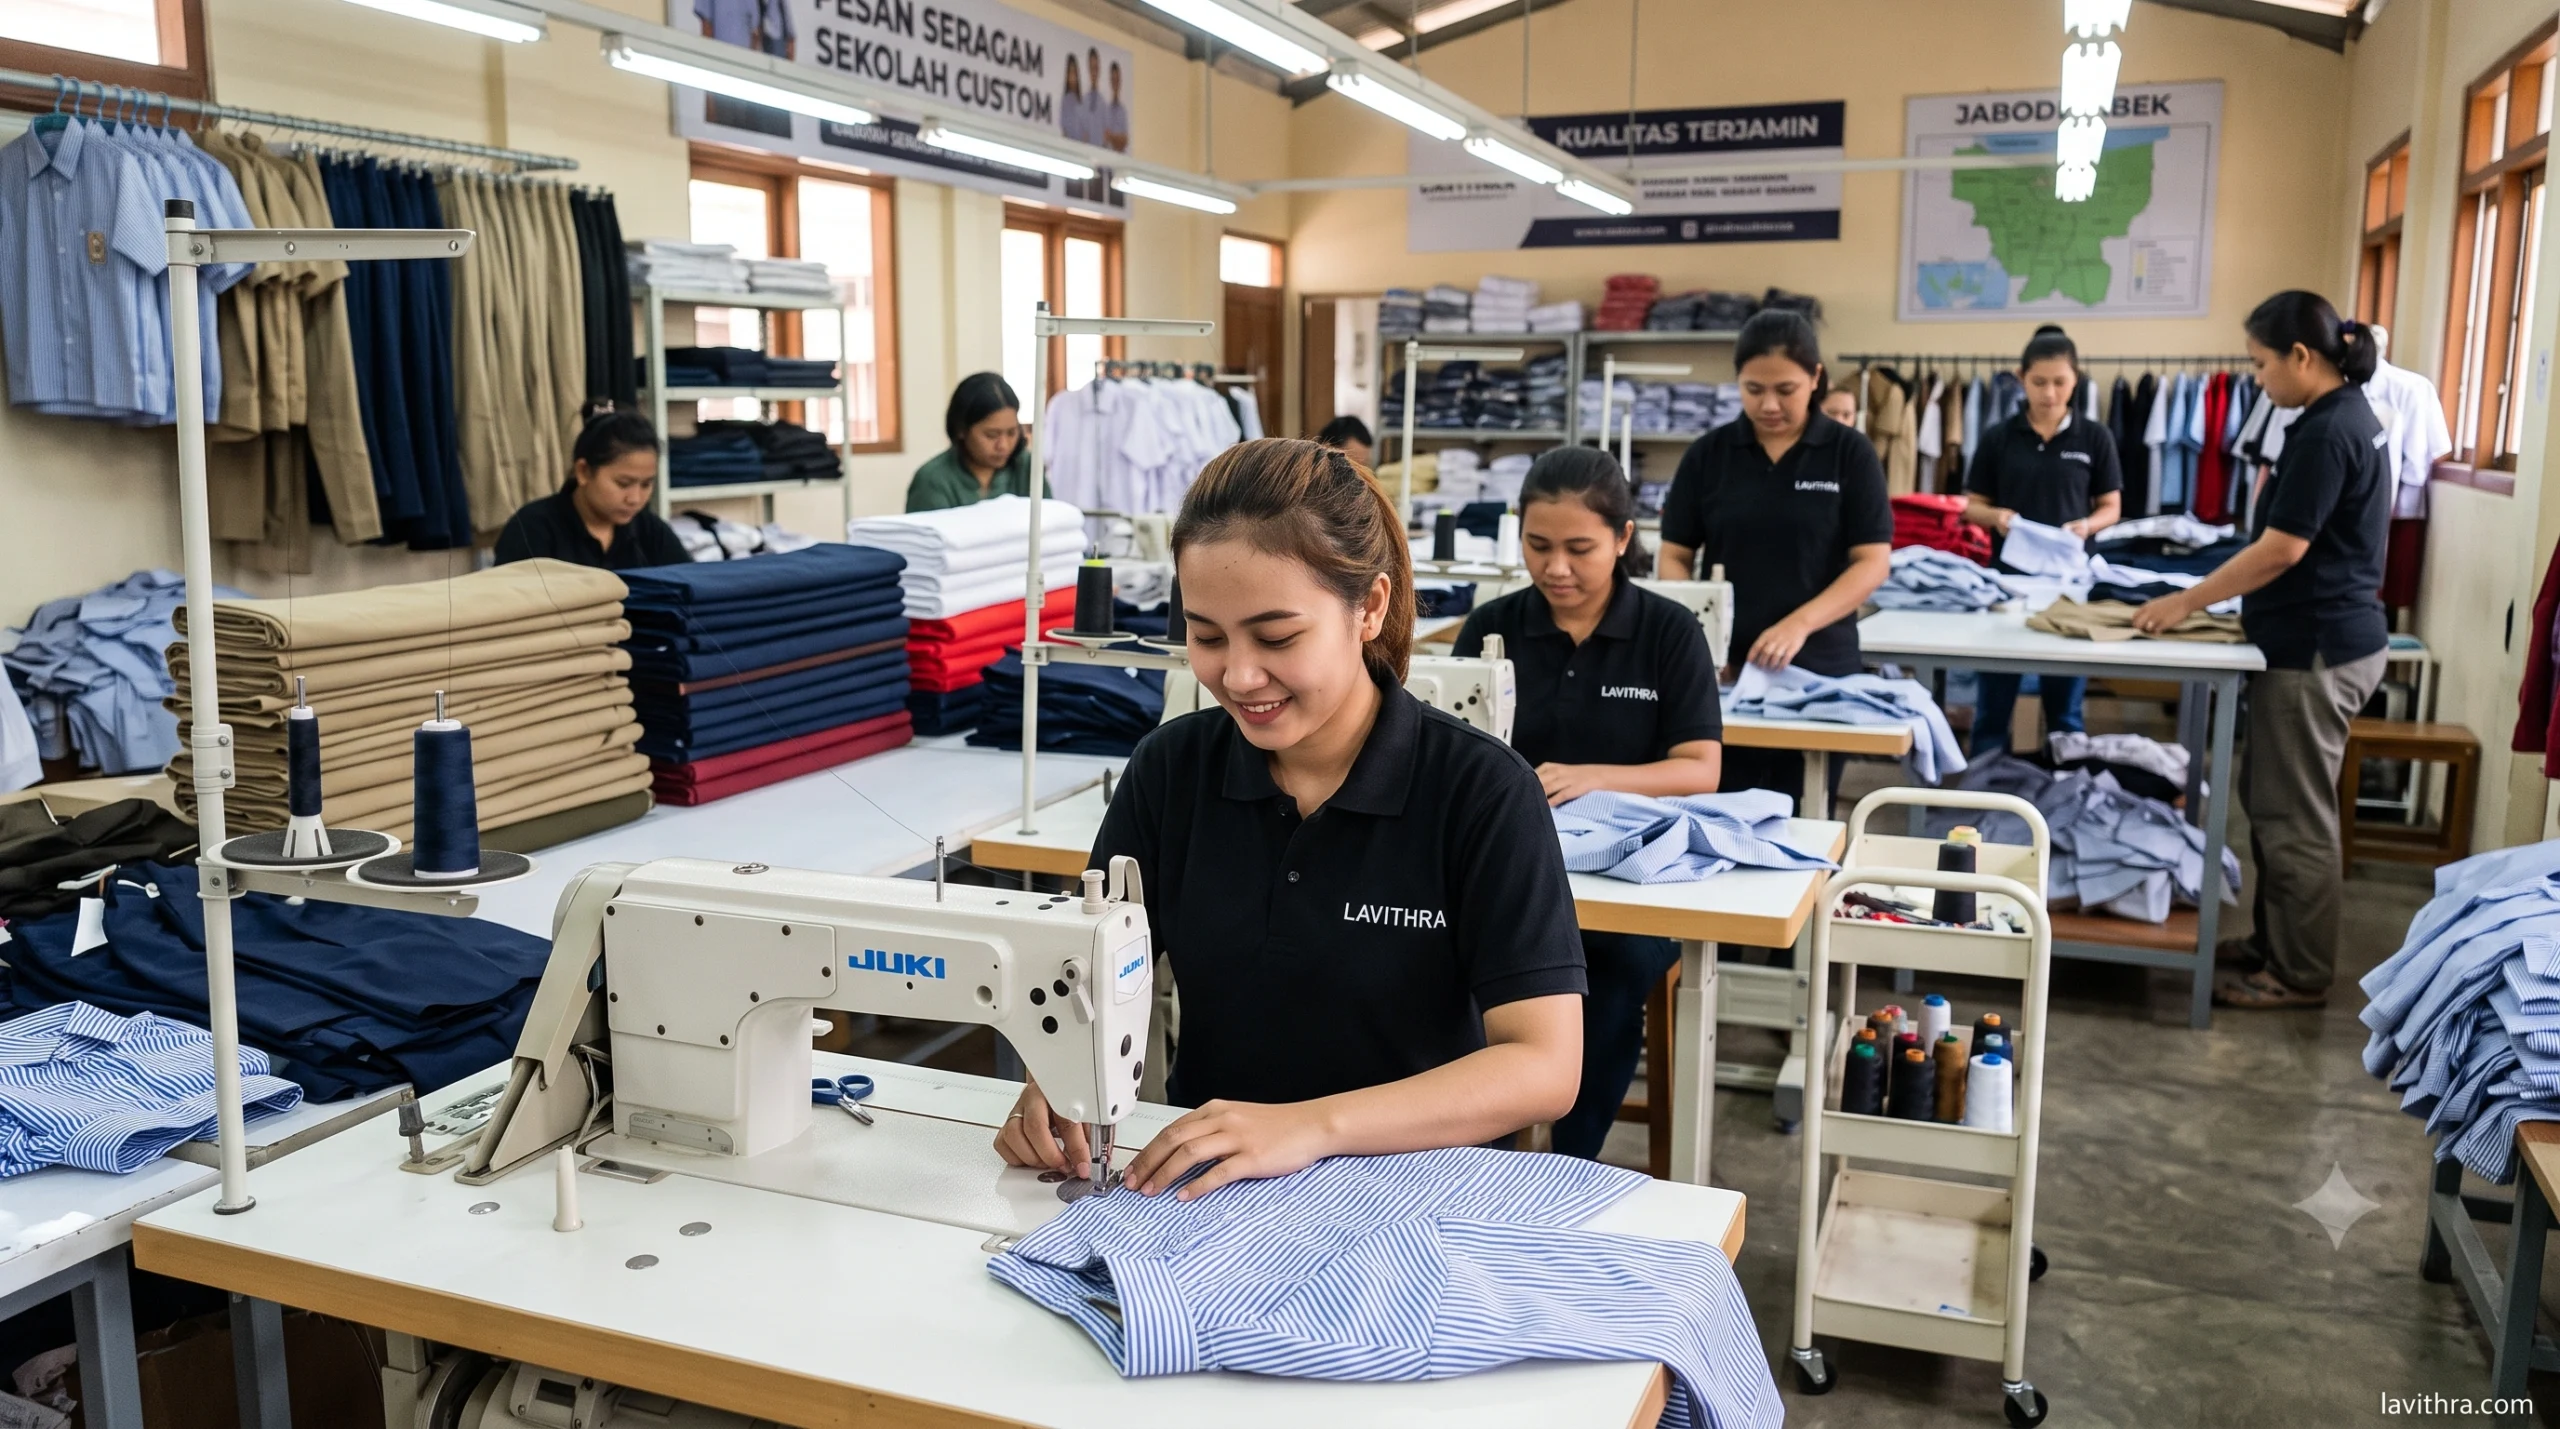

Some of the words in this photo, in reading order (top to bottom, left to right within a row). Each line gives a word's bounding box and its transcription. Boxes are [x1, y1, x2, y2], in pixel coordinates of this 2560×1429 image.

[814, 0, 914, 38] ESAN
[922, 6, 1044, 78] SERAGAM
[815, 27, 948, 97] SEKOLAH
[956, 69, 1053, 124] CUSTOM
[1556, 121, 1680, 147] KUALITAS
[1685, 115, 1820, 143] TERJAMIN
[1601, 685, 1659, 701] LAVITHRA
[1343, 902, 1447, 929] LAVITHRA
[848, 948, 946, 980] JUKI
[1119, 955, 1144, 979] JUKI
